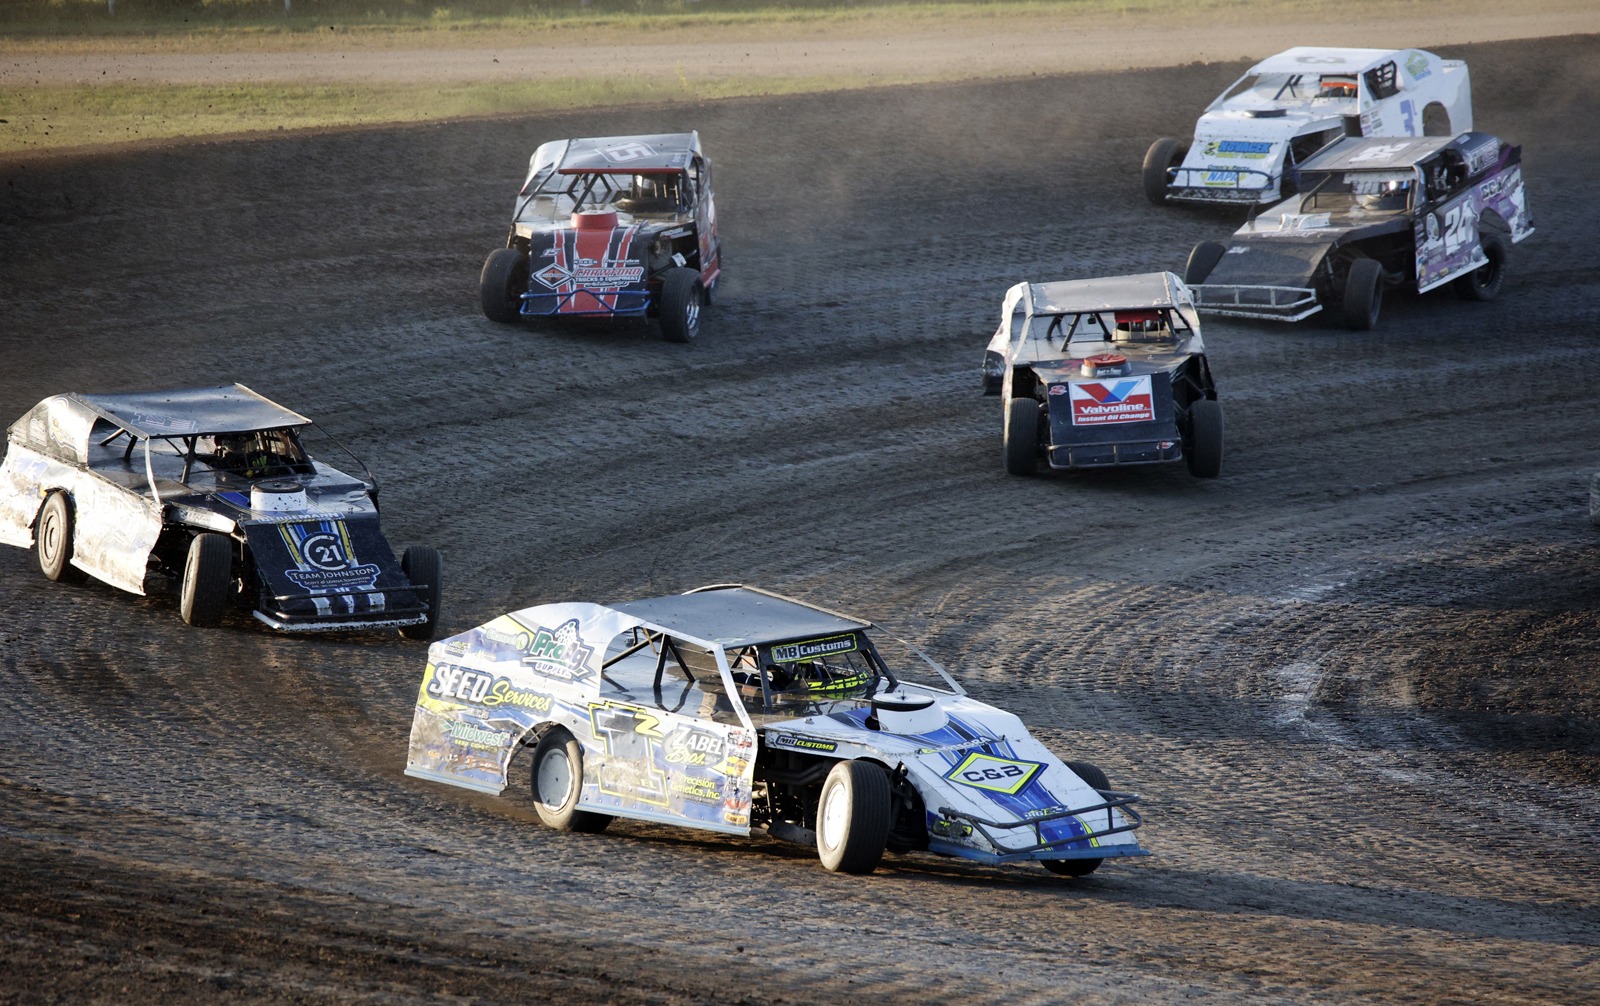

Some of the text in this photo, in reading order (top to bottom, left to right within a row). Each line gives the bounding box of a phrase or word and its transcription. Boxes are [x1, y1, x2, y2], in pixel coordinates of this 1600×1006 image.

[1080, 403, 1145, 414] Valvoline
[1120, 412, 1150, 420] Change
[291, 566, 375, 581] TEAM JOHNSTON
[774, 639, 852, 660] MB Customs
[536, 661, 567, 677] SUPPLY
[429, 664, 551, 712] SEED Services
[450, 721, 506, 747] Midwest
[672, 725, 723, 756] ZABEL
[796, 740, 836, 751] CUSTOMS
[665, 746, 706, 765] Bros.
[962, 764, 1025, 783] C&B
